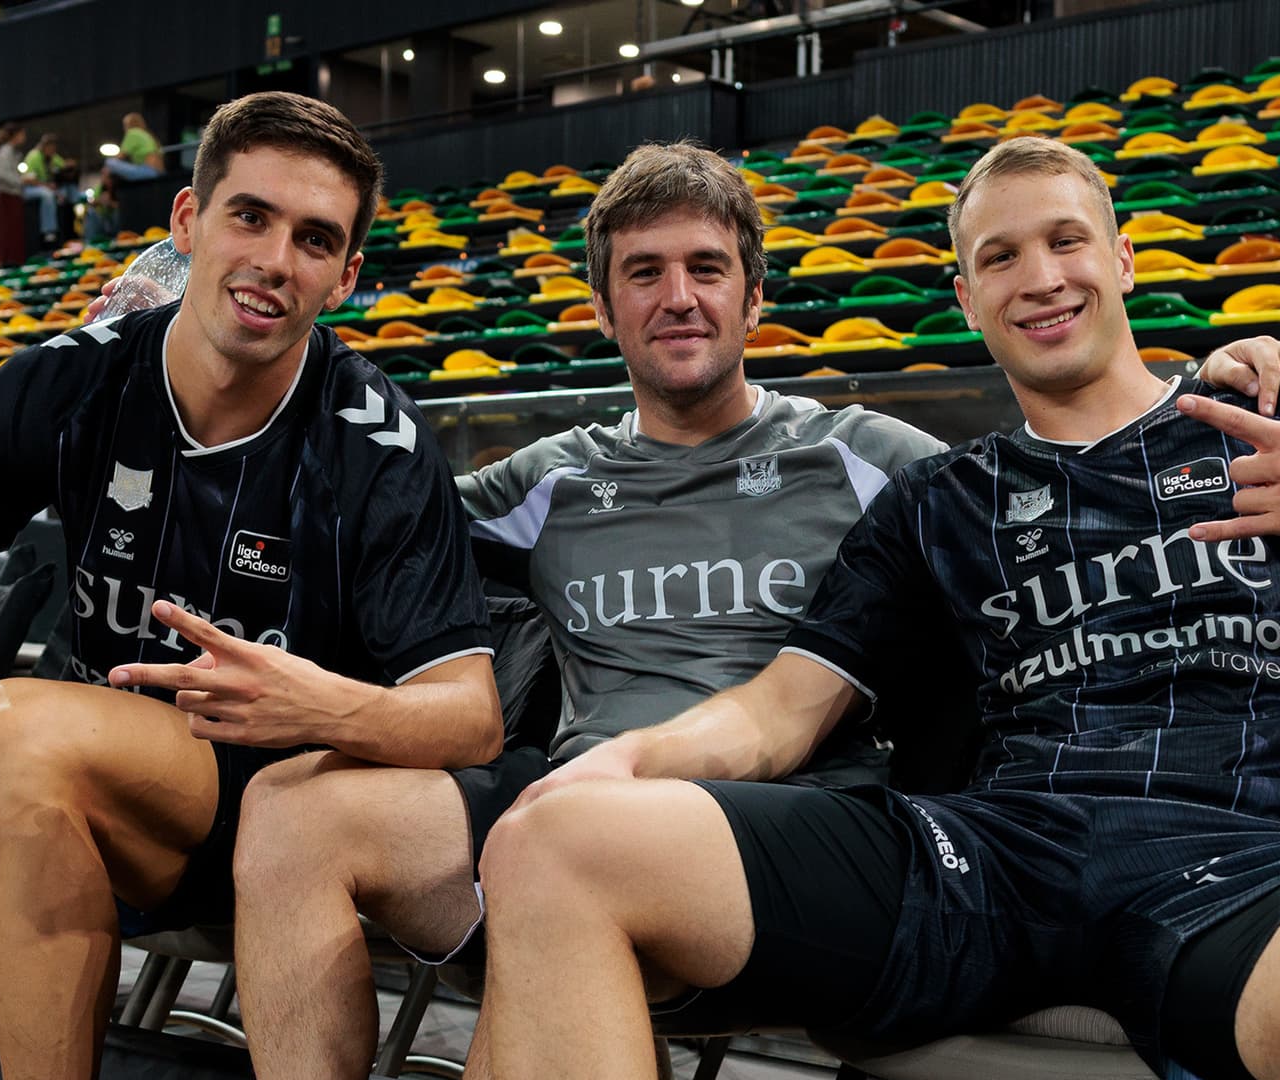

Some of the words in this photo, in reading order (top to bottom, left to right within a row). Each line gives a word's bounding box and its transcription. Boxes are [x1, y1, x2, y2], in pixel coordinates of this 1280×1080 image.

[1163, 474, 1189, 486] liga
[1164, 476, 1223, 494] endesa
[237, 544, 261, 559] liga
[1015, 544, 1050, 563] hummel
[235, 558, 286, 576] endesa
[980, 528, 1272, 641] surne
[564, 556, 807, 633] surne
